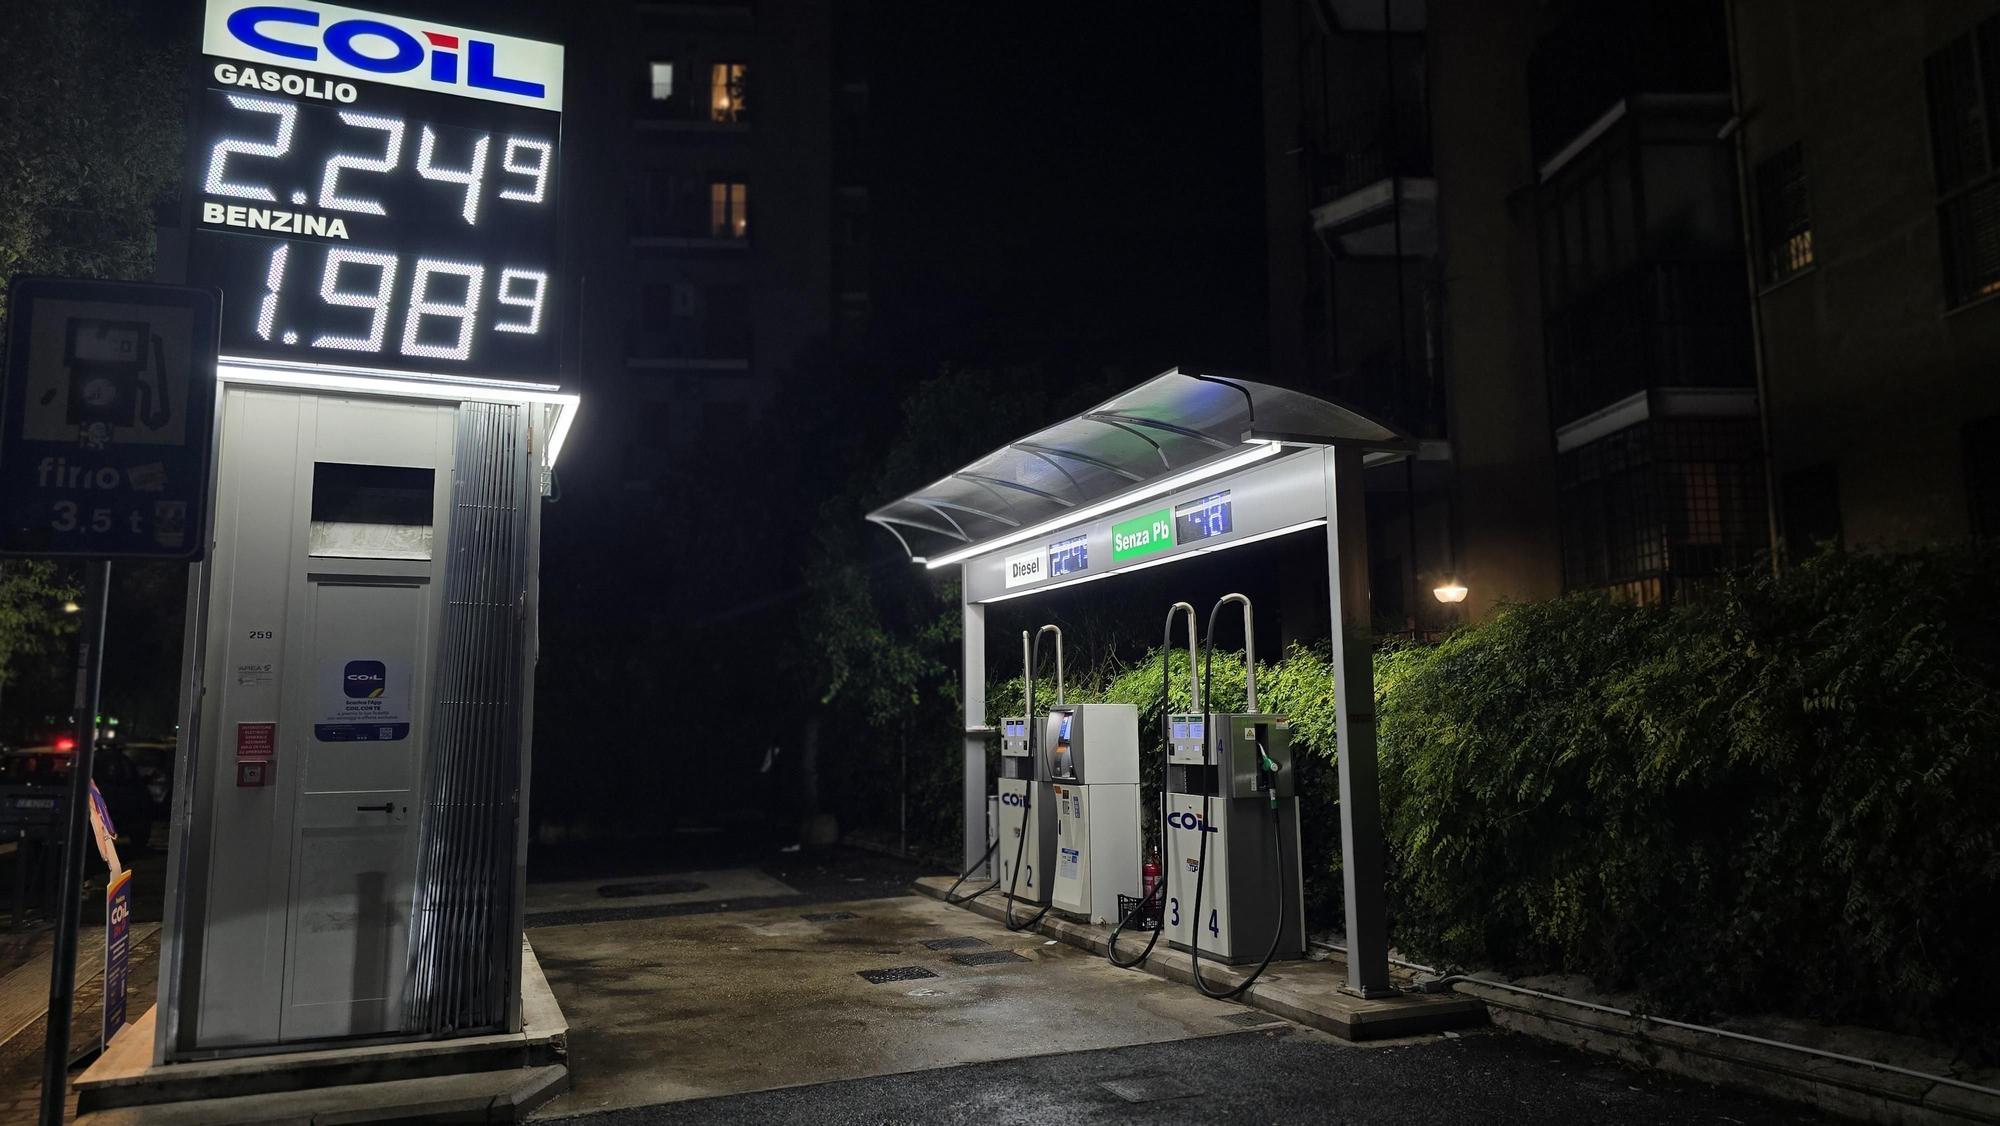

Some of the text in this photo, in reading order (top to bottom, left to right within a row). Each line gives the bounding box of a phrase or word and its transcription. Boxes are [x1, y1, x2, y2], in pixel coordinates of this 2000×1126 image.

[213, 63, 358, 104] GASOLIO
[203, 202, 349, 240] BENZINA
[129, 510, 143, 534] t
[1115, 520, 1169, 553] Senza Pb
[1012, 557, 1040, 578] Diesel
[249, 631, 273, 639] 259
[1217, 739, 1223, 754] 4
[1004, 859, 1009, 881] 1
[1026, 865, 1033, 888] 2
[1170, 897, 1180, 926] 3
[1208, 908, 1219, 938] 4
